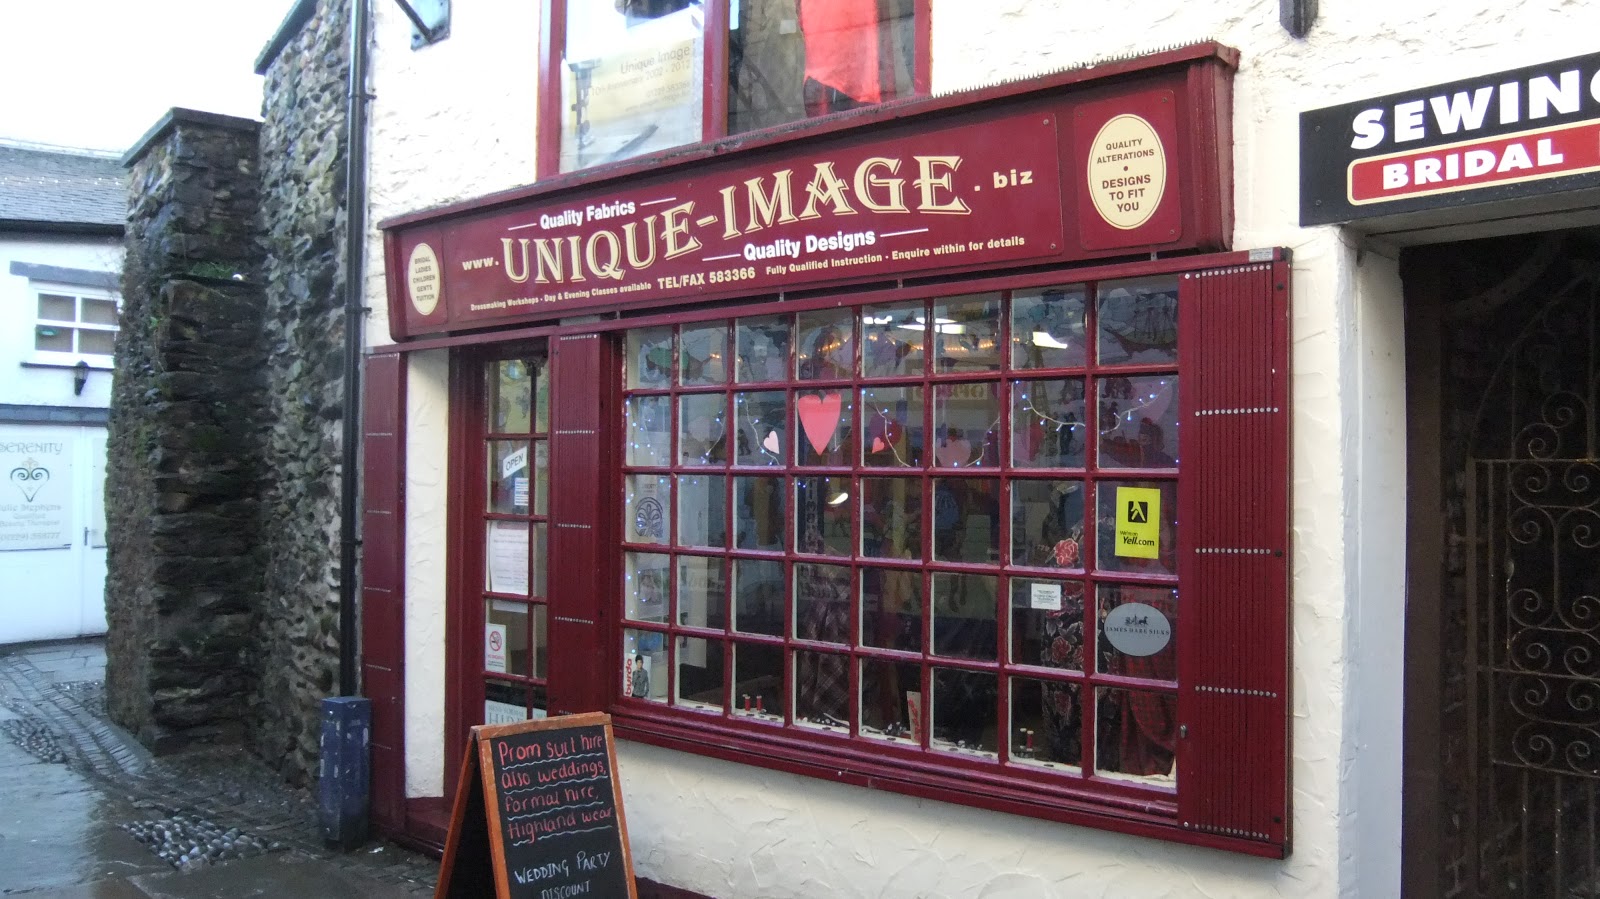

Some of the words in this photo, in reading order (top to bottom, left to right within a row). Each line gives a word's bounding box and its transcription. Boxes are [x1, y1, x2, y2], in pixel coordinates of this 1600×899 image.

[658, 46, 690, 61] Image
[1350, 68, 1600, 150] SEWIN
[1106, 138, 1142, 150] QUALITY
[1096, 148, 1154, 164] ALTERATIONS
[1383, 138, 1564, 190] BRIDAL
[1102, 174, 1151, 190] DESIGNS
[1109, 192, 1124, 201] TO
[1128, 188, 1146, 198] FIT
[540, 210, 584, 230] Quality
[586, 200, 636, 221] Fabrics
[1117, 202, 1140, 212] YOU
[744, 240, 800, 260] Quality
[805, 230, 876, 252] Designs
[414, 256, 430, 264] BRIDAL
[412, 274, 436, 284] CHILDREN
[416, 266, 432, 274] LADIES
[470, 300, 506, 312] Dressmaking
[507, 296, 538, 308] Workshops
[544, 294, 556, 304] Day
[558, 292, 562, 300] &
[564, 288, 590, 300] Evening
[592, 286, 618, 296] Classes
[620, 282, 652, 294] available
[658, 272, 706, 290] TEL/FAX
[710, 267, 756, 284] 583366
[766, 264, 787, 276] Fully
[789, 258, 828, 272] Qualified
[831, 252, 882, 267] Instruction
[892, 248, 930, 261] Enquire
[933, 242, 965, 256] within
[968, 240, 984, 250] for
[987, 236, 1025, 249] details
[416, 284, 432, 292] GENTS
[506, 453, 524, 471] OPEN
[1123, 536, 1155, 546] Yell.com
[498, 741, 541, 766] Prom
[581, 734, 602, 751] hire
[538, 760, 606, 783] weddings,
[505, 792, 560, 812] formal
[508, 813, 576, 844] Highland
[582, 807, 612, 822] wear
[514, 860, 570, 884] WEDDING
[576, 850, 610, 870] PARTY
[542, 880, 591, 899] DISCOUNT
